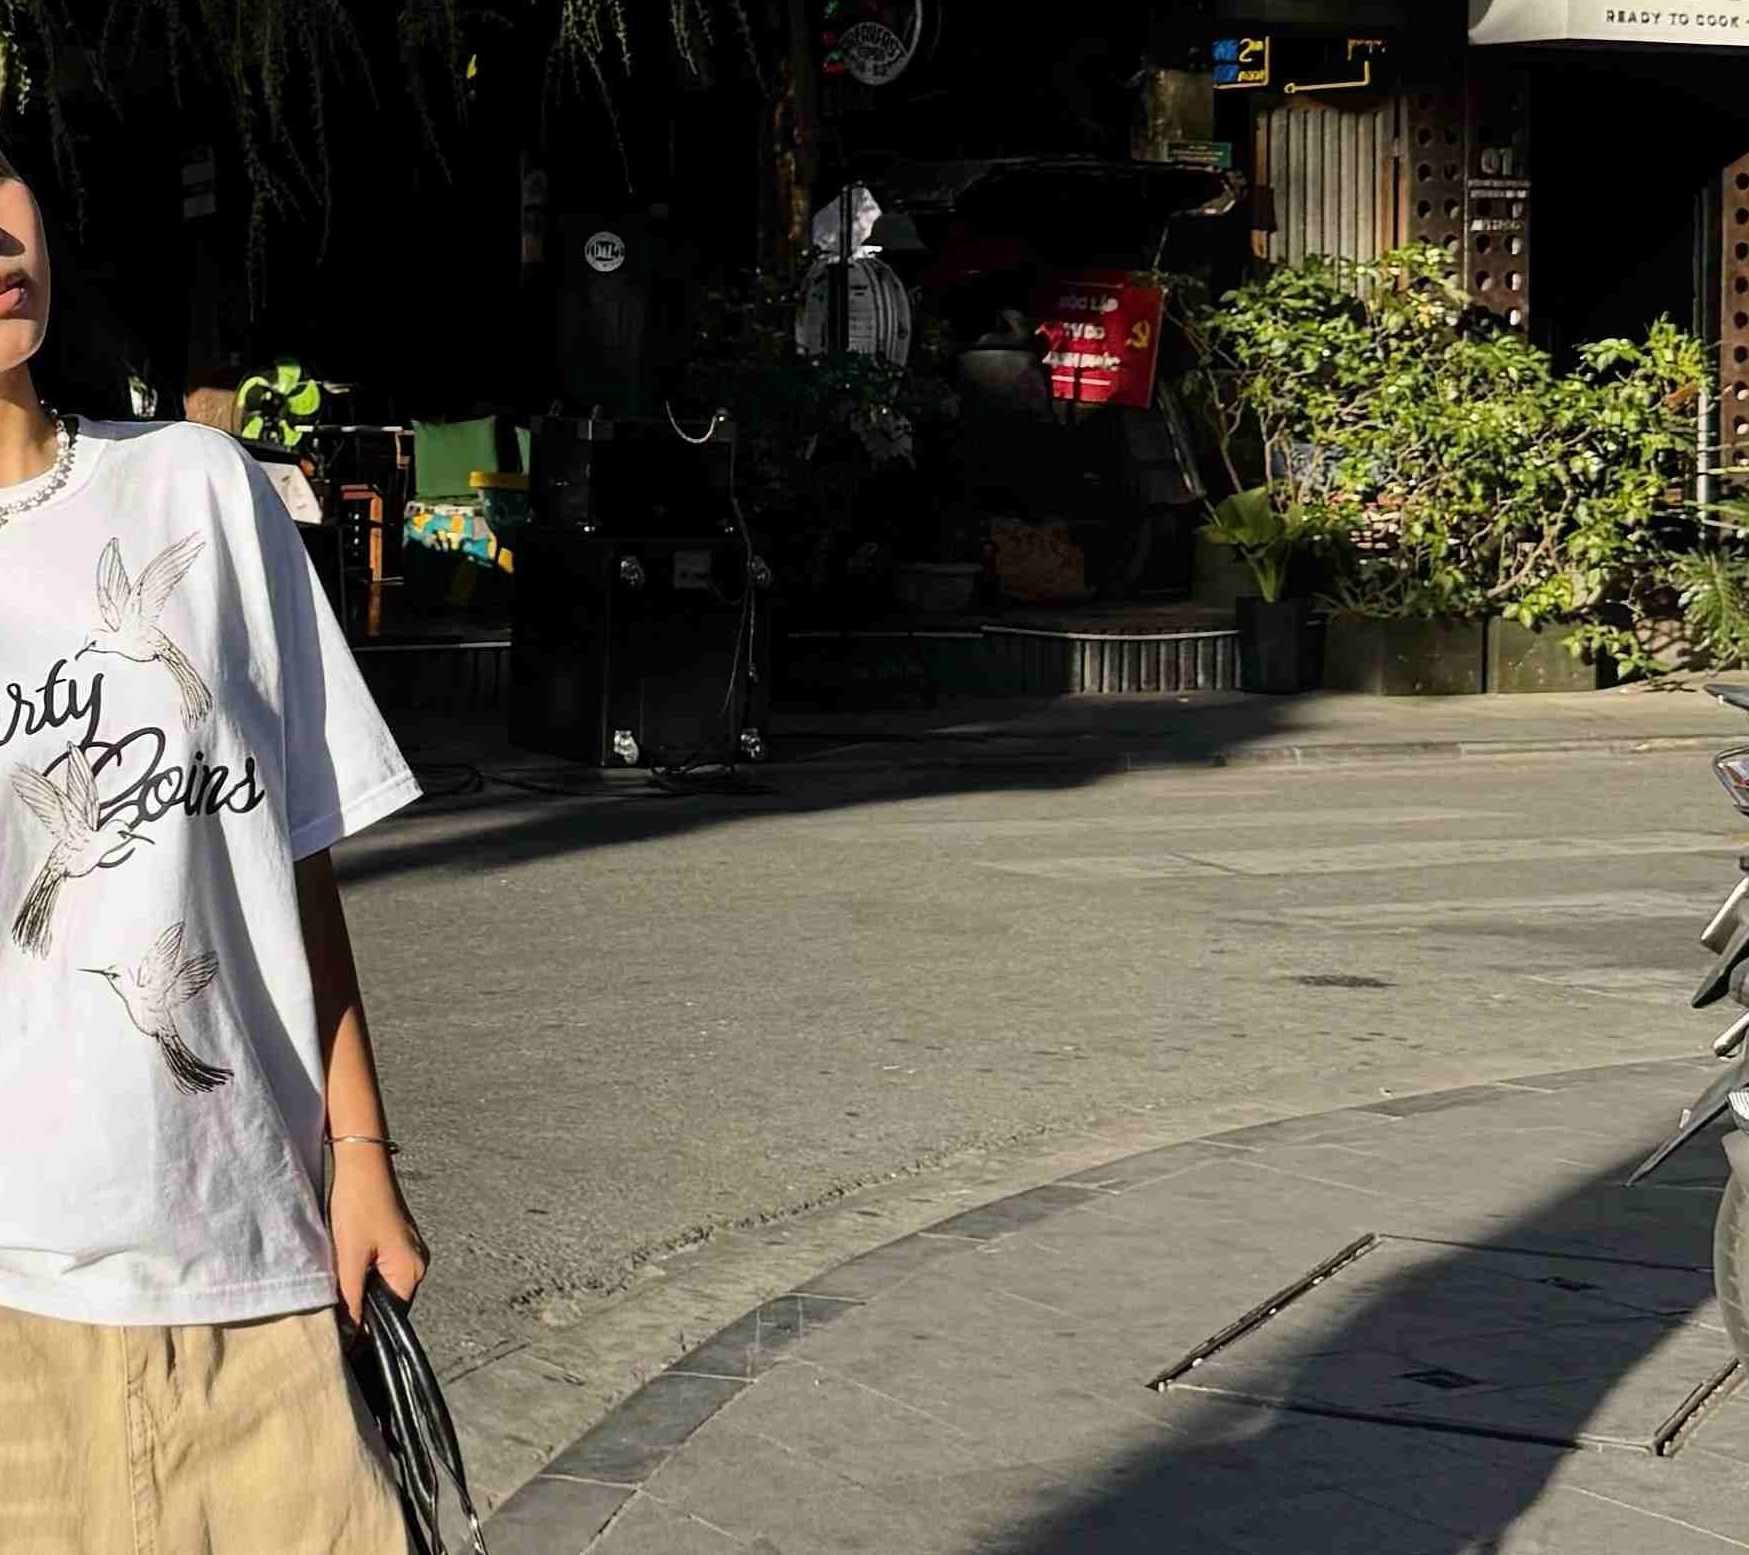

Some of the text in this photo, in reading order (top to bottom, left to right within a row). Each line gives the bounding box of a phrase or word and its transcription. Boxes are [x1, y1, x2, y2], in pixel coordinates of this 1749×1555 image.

[1605, 9, 1741, 28] READY TO COOK
[42, 726, 266, 868] Coins
